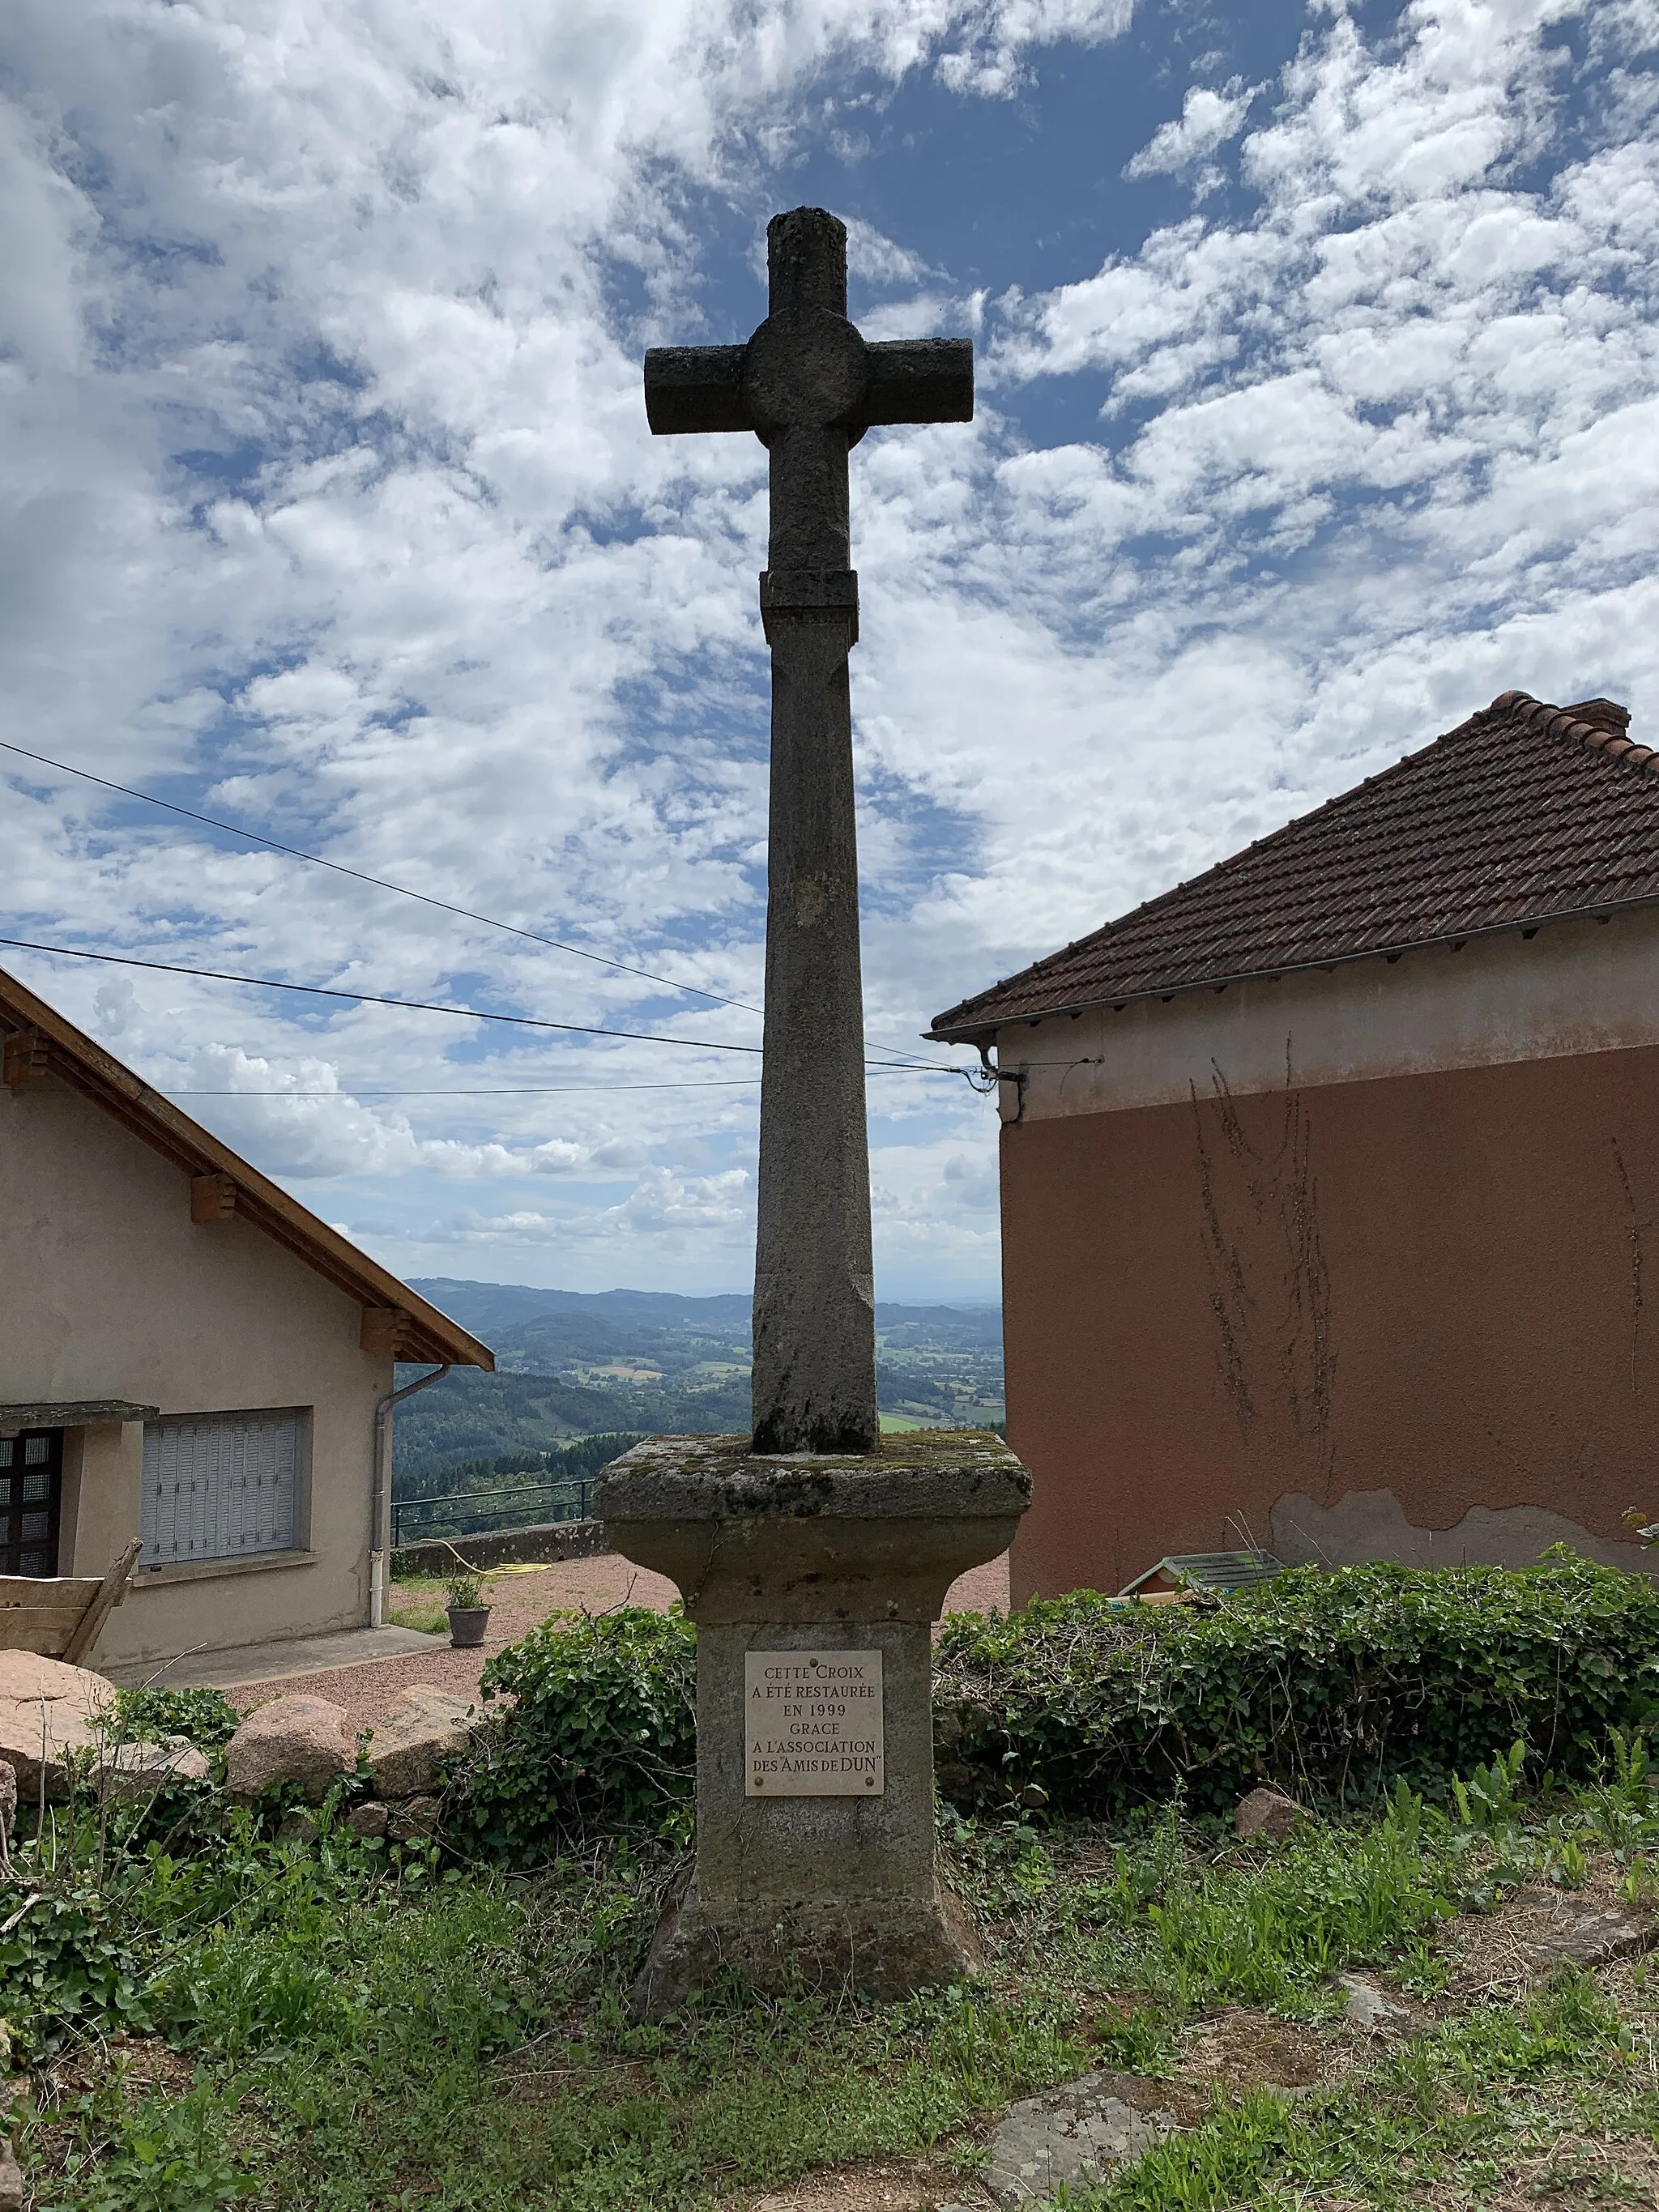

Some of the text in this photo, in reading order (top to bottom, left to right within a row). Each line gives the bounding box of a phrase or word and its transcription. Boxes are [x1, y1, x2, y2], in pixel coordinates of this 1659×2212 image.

[764, 1667, 810, 1679] CETTE
[752, 1682, 876, 1698] A ÉTÉ RESTAURÉE
[783, 1704, 847, 1717] EN 1999
[790, 1723, 840, 1735] GRACE
[766, 1741, 876, 1754] L'ASSOCIATION
[753, 1759, 778, 1772] DES
[821, 1759, 838, 1772] DE
